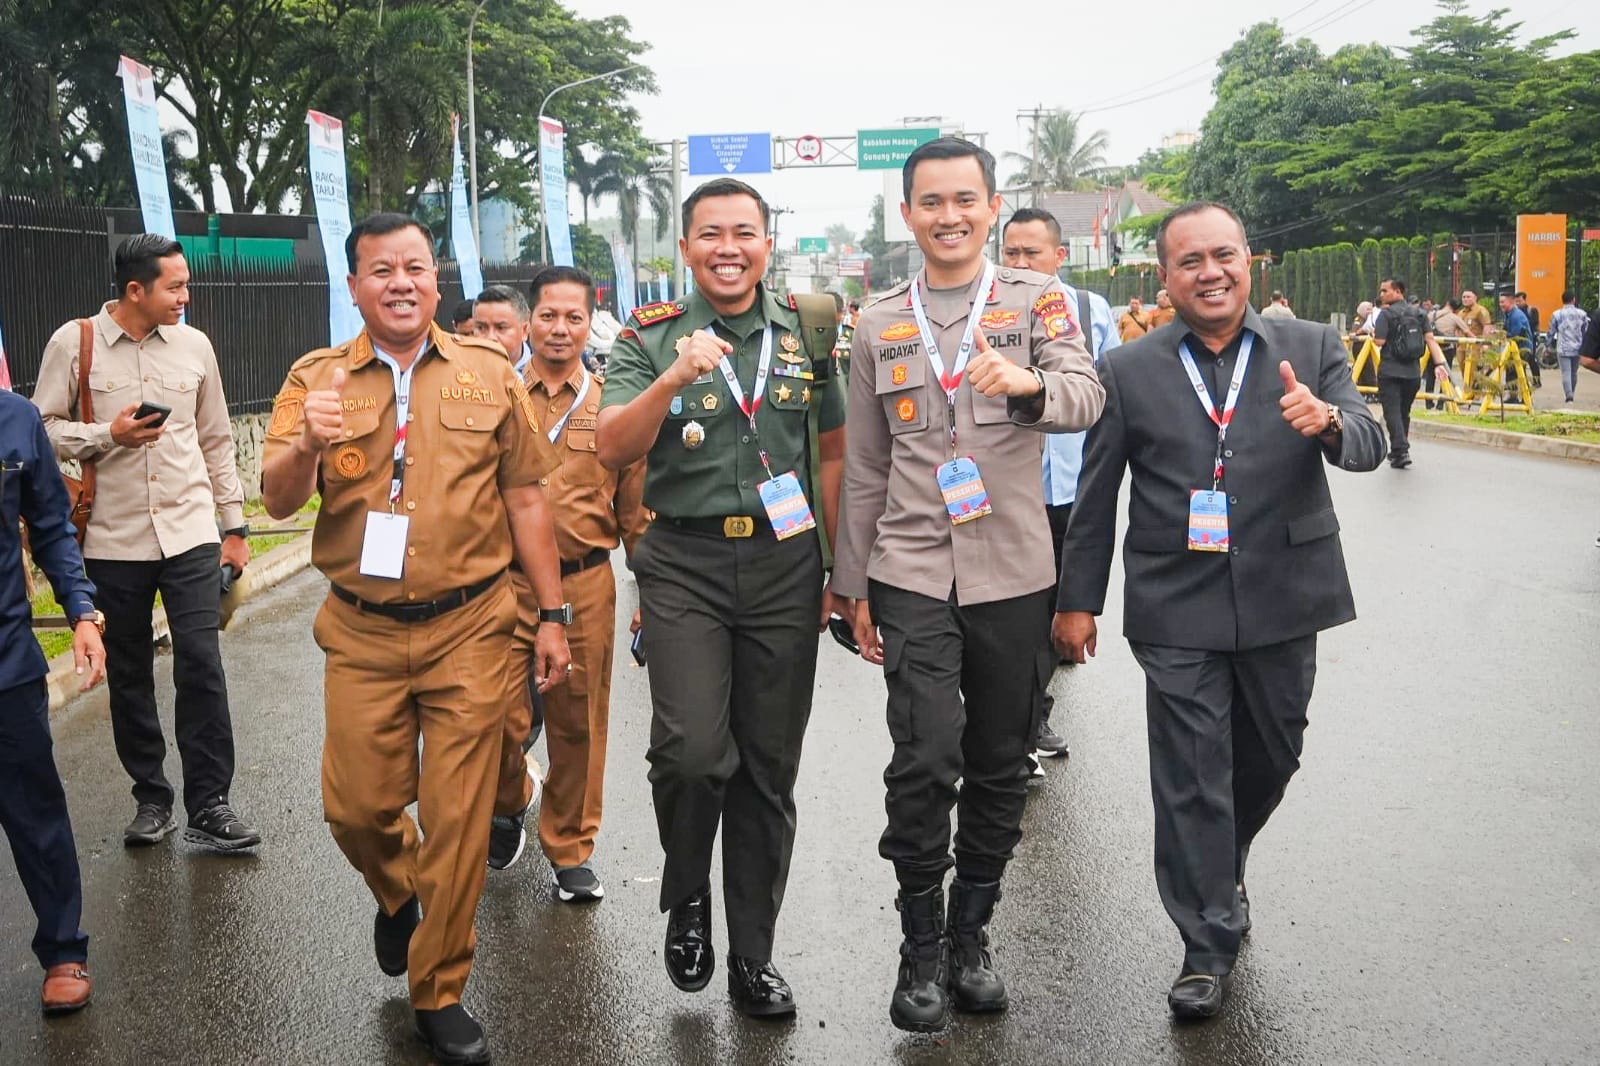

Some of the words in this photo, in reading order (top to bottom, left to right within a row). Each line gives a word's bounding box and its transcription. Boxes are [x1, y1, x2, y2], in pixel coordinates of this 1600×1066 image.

[862, 138, 891, 147] Babakan
[892, 137, 918, 147] Madang
[862, 152, 890, 162] Gunung
[891, 152, 912, 161] Panc
[1527, 232, 1561, 241] HARRIS
[1040, 304, 1064, 315] RIAU
[976, 333, 1022, 349] OLRI
[879, 343, 920, 362] HIDAYAT
[441, 386, 494, 402] BUPATI
[340, 396, 377, 412] ARDIMAN
